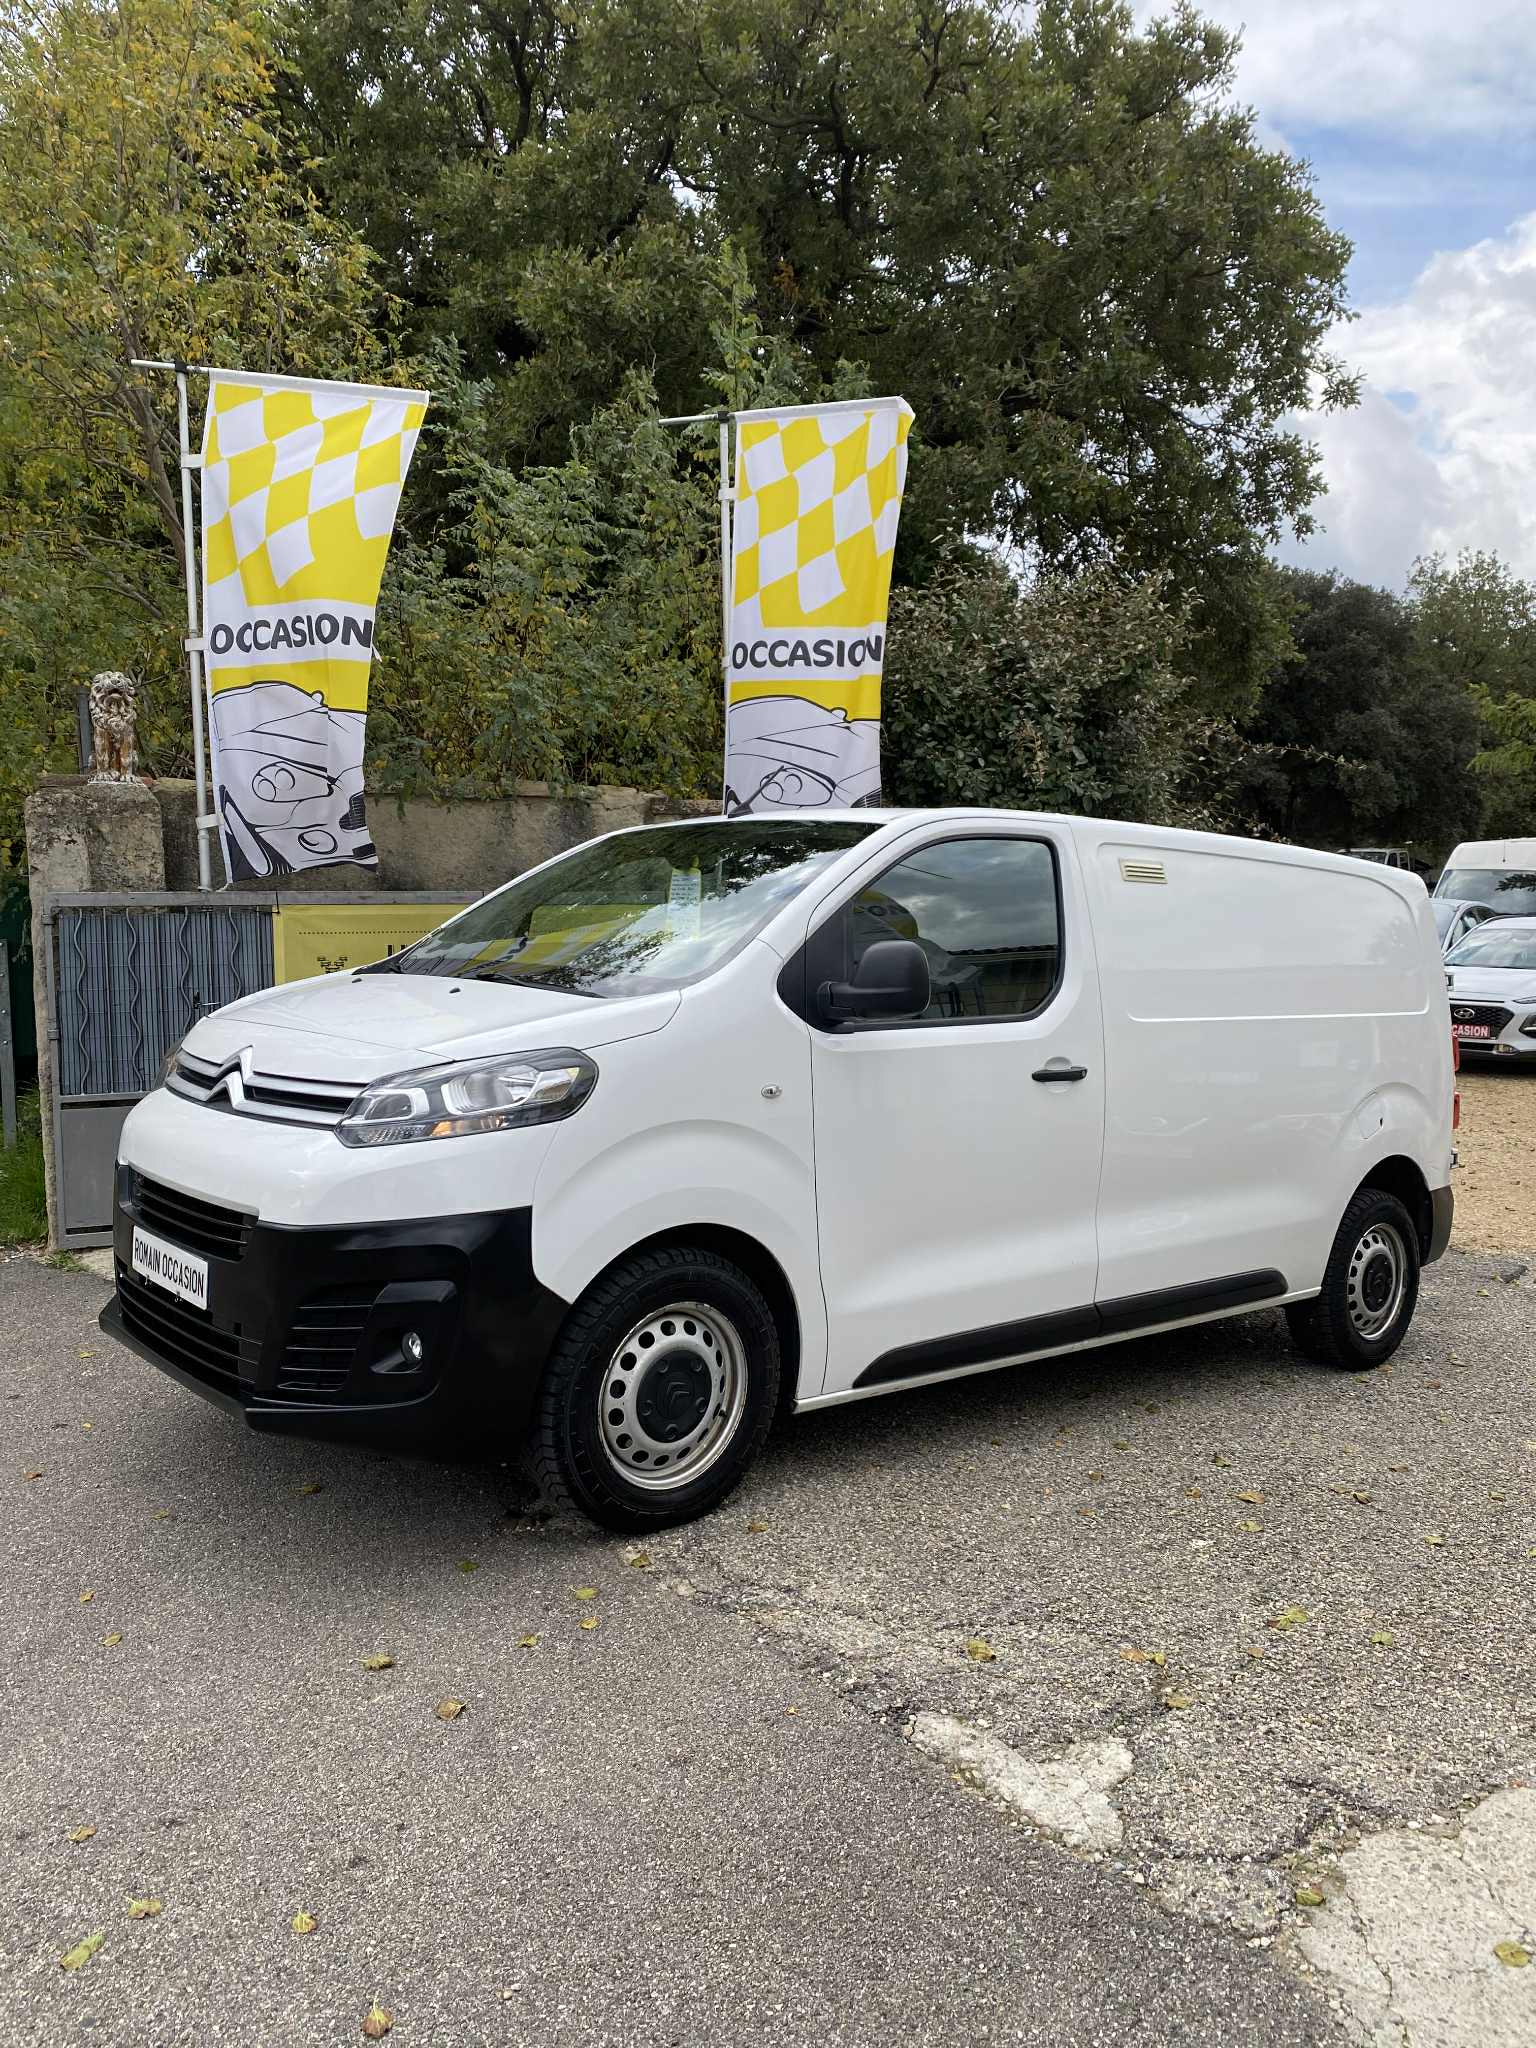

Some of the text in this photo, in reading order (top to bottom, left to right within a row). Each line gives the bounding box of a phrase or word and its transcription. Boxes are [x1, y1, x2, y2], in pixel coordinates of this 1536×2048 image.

[210, 613, 373, 654] OCCASION
[732, 635, 882, 669] OCCASION
[134, 1238, 205, 1298] ROMAIN OCCASION
